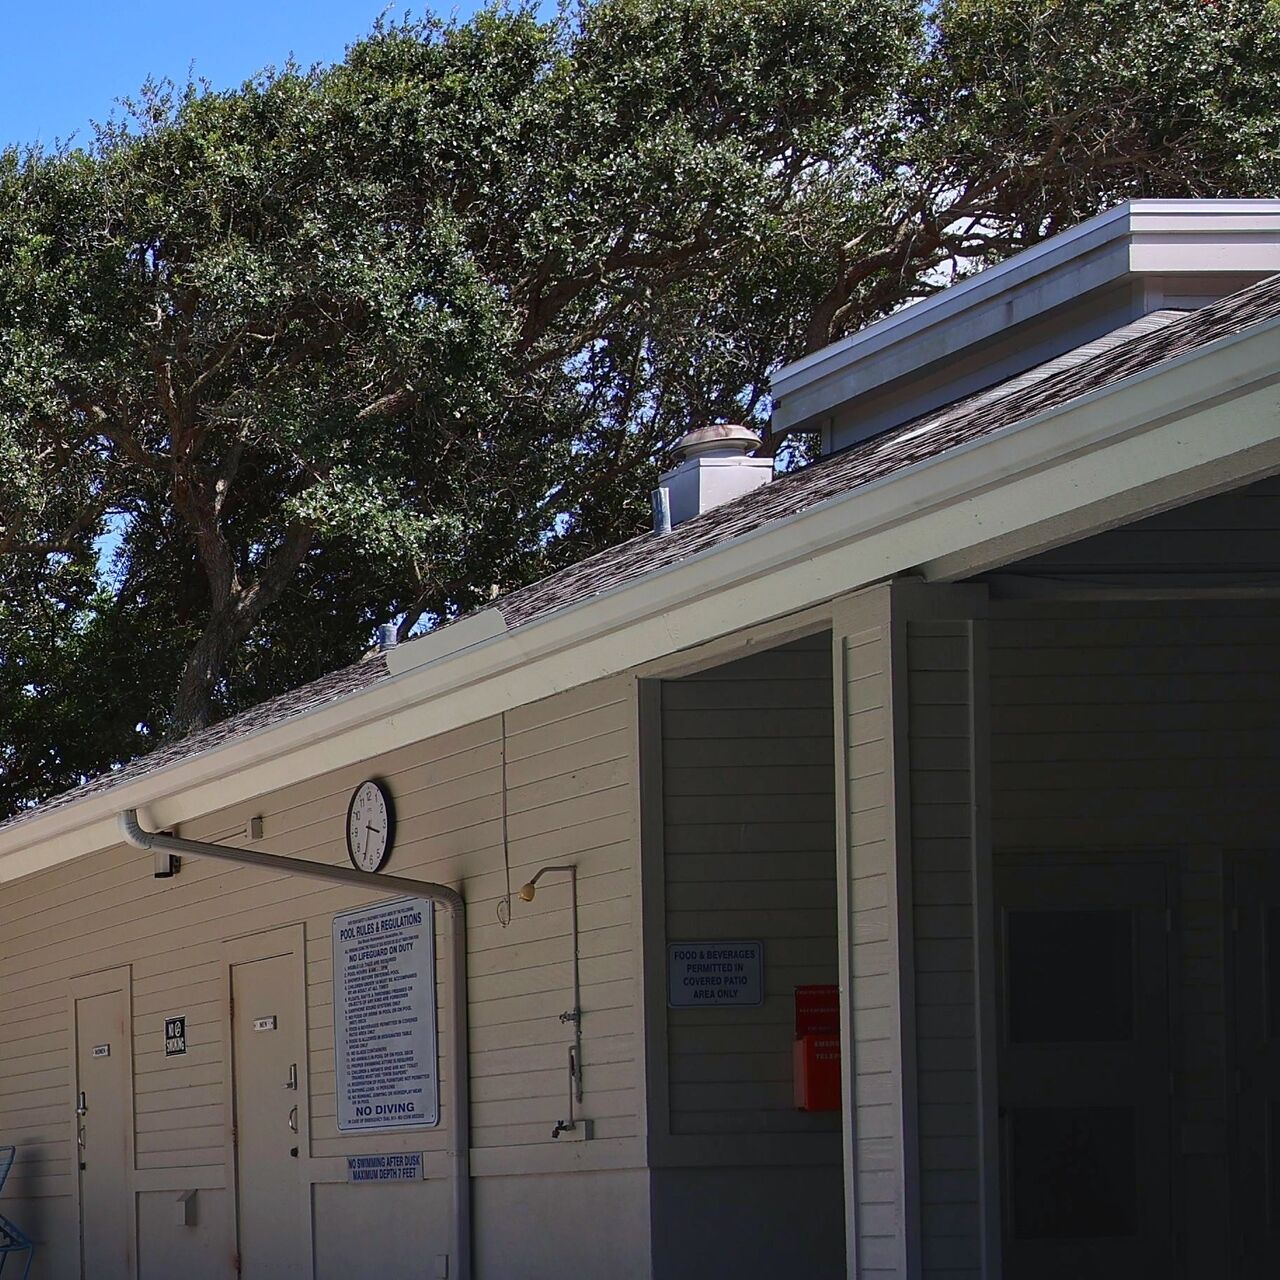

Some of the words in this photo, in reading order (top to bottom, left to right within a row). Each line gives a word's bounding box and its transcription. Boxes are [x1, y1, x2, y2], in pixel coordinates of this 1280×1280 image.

[340, 928, 355, 941] POOL
[356, 923, 374, 936] RULES
[381, 912, 422, 931] REGULATIONS
[349, 954, 358, 962] NO
[358, 948, 388, 961] LIFEGUARD
[389, 946, 397, 954] ON
[399, 942, 414, 953] DUTY
[674, 951, 697, 960] FOOD
[699, 951, 705, 960] &
[706, 950, 755, 960] BEVERAGES
[687, 963, 733, 973] PERMITTED
[734, 963, 744, 972] IN
[683, 977, 722, 986] COVERED
[724, 976, 748, 985] PATIO
[693, 990, 715, 999] AREA
[717, 989, 738, 998] ONLY
[166, 1037, 184, 1052] SMOKING
[356, 1106, 372, 1116] NO
[375, 1102, 415, 1115] DIVING
[348, 1158, 357, 1169] NO
[357, 1156, 386, 1169] SWIMMING
[386, 1156, 404, 1167] AFTER
[404, 1155, 420, 1166] DUSK
[352, 1169, 378, 1180] MAXIMUM
[379, 1168, 397, 1179] DEPTH
[402, 1168, 416, 1178] FEET
